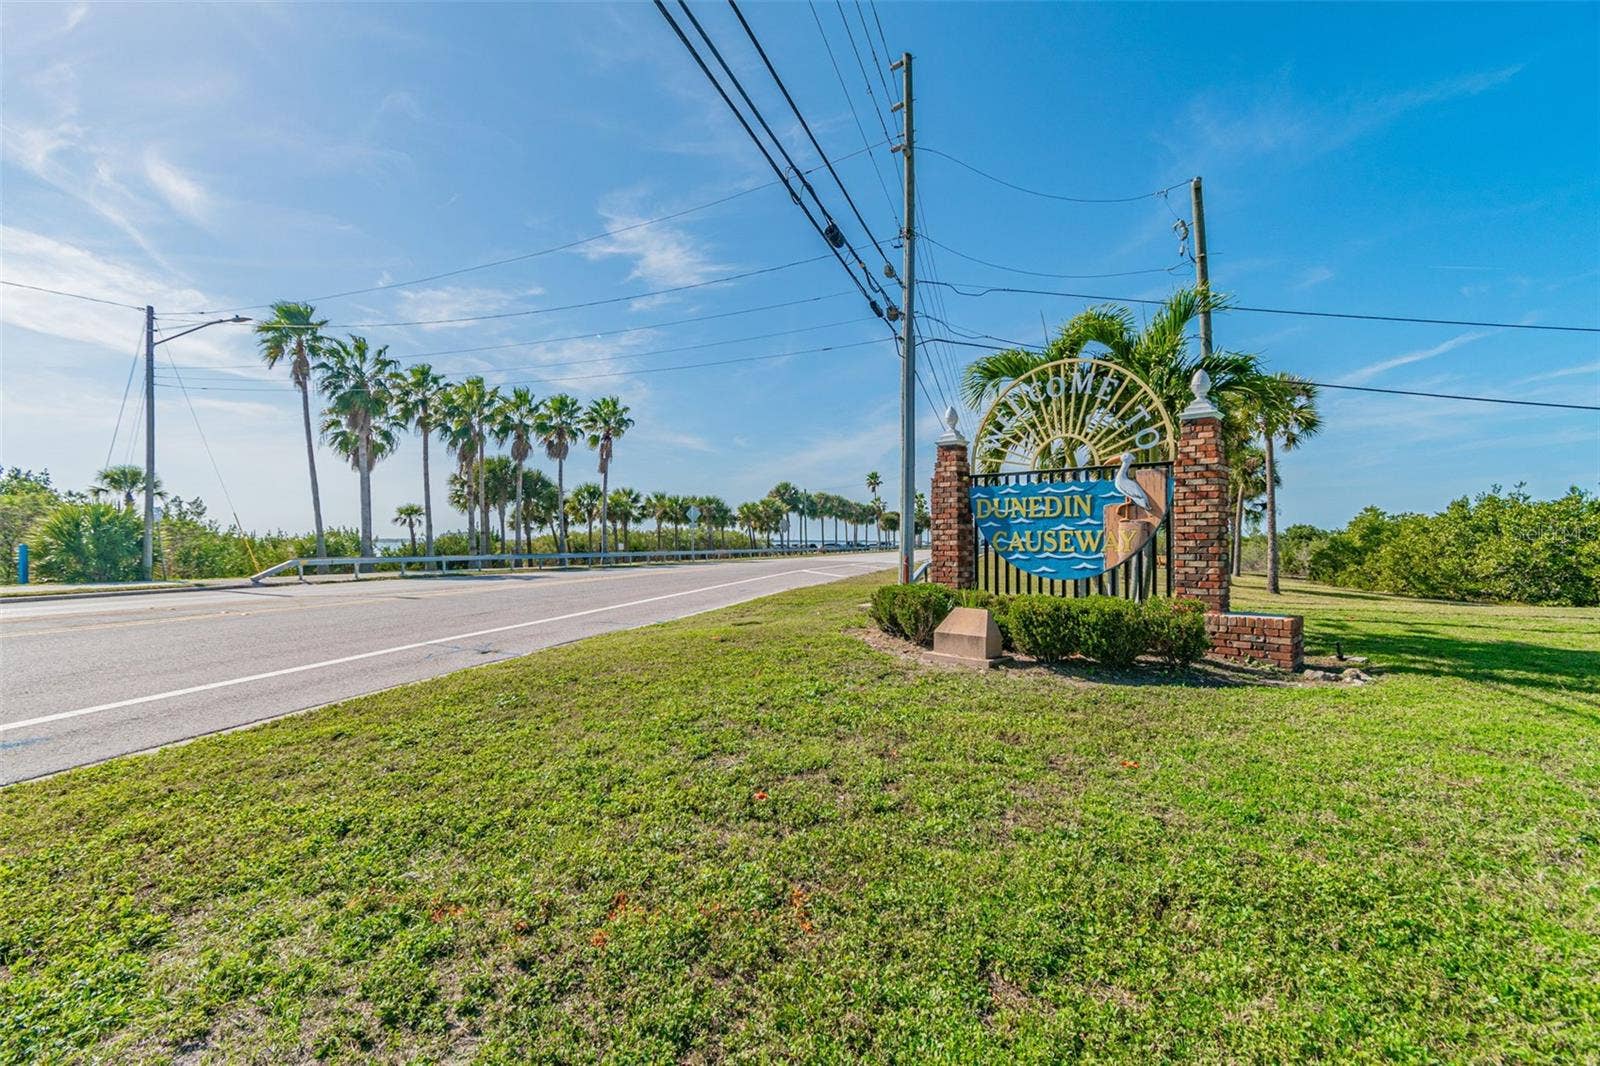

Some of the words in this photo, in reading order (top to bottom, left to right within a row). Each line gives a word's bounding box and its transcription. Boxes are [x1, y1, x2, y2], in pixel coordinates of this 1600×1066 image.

[979, 372, 1120, 451] WELCOME
[1124, 404, 1160, 450] TO
[976, 494, 1092, 518] DUNEDIN
[992, 529, 1137, 553] CAUSEWAY
